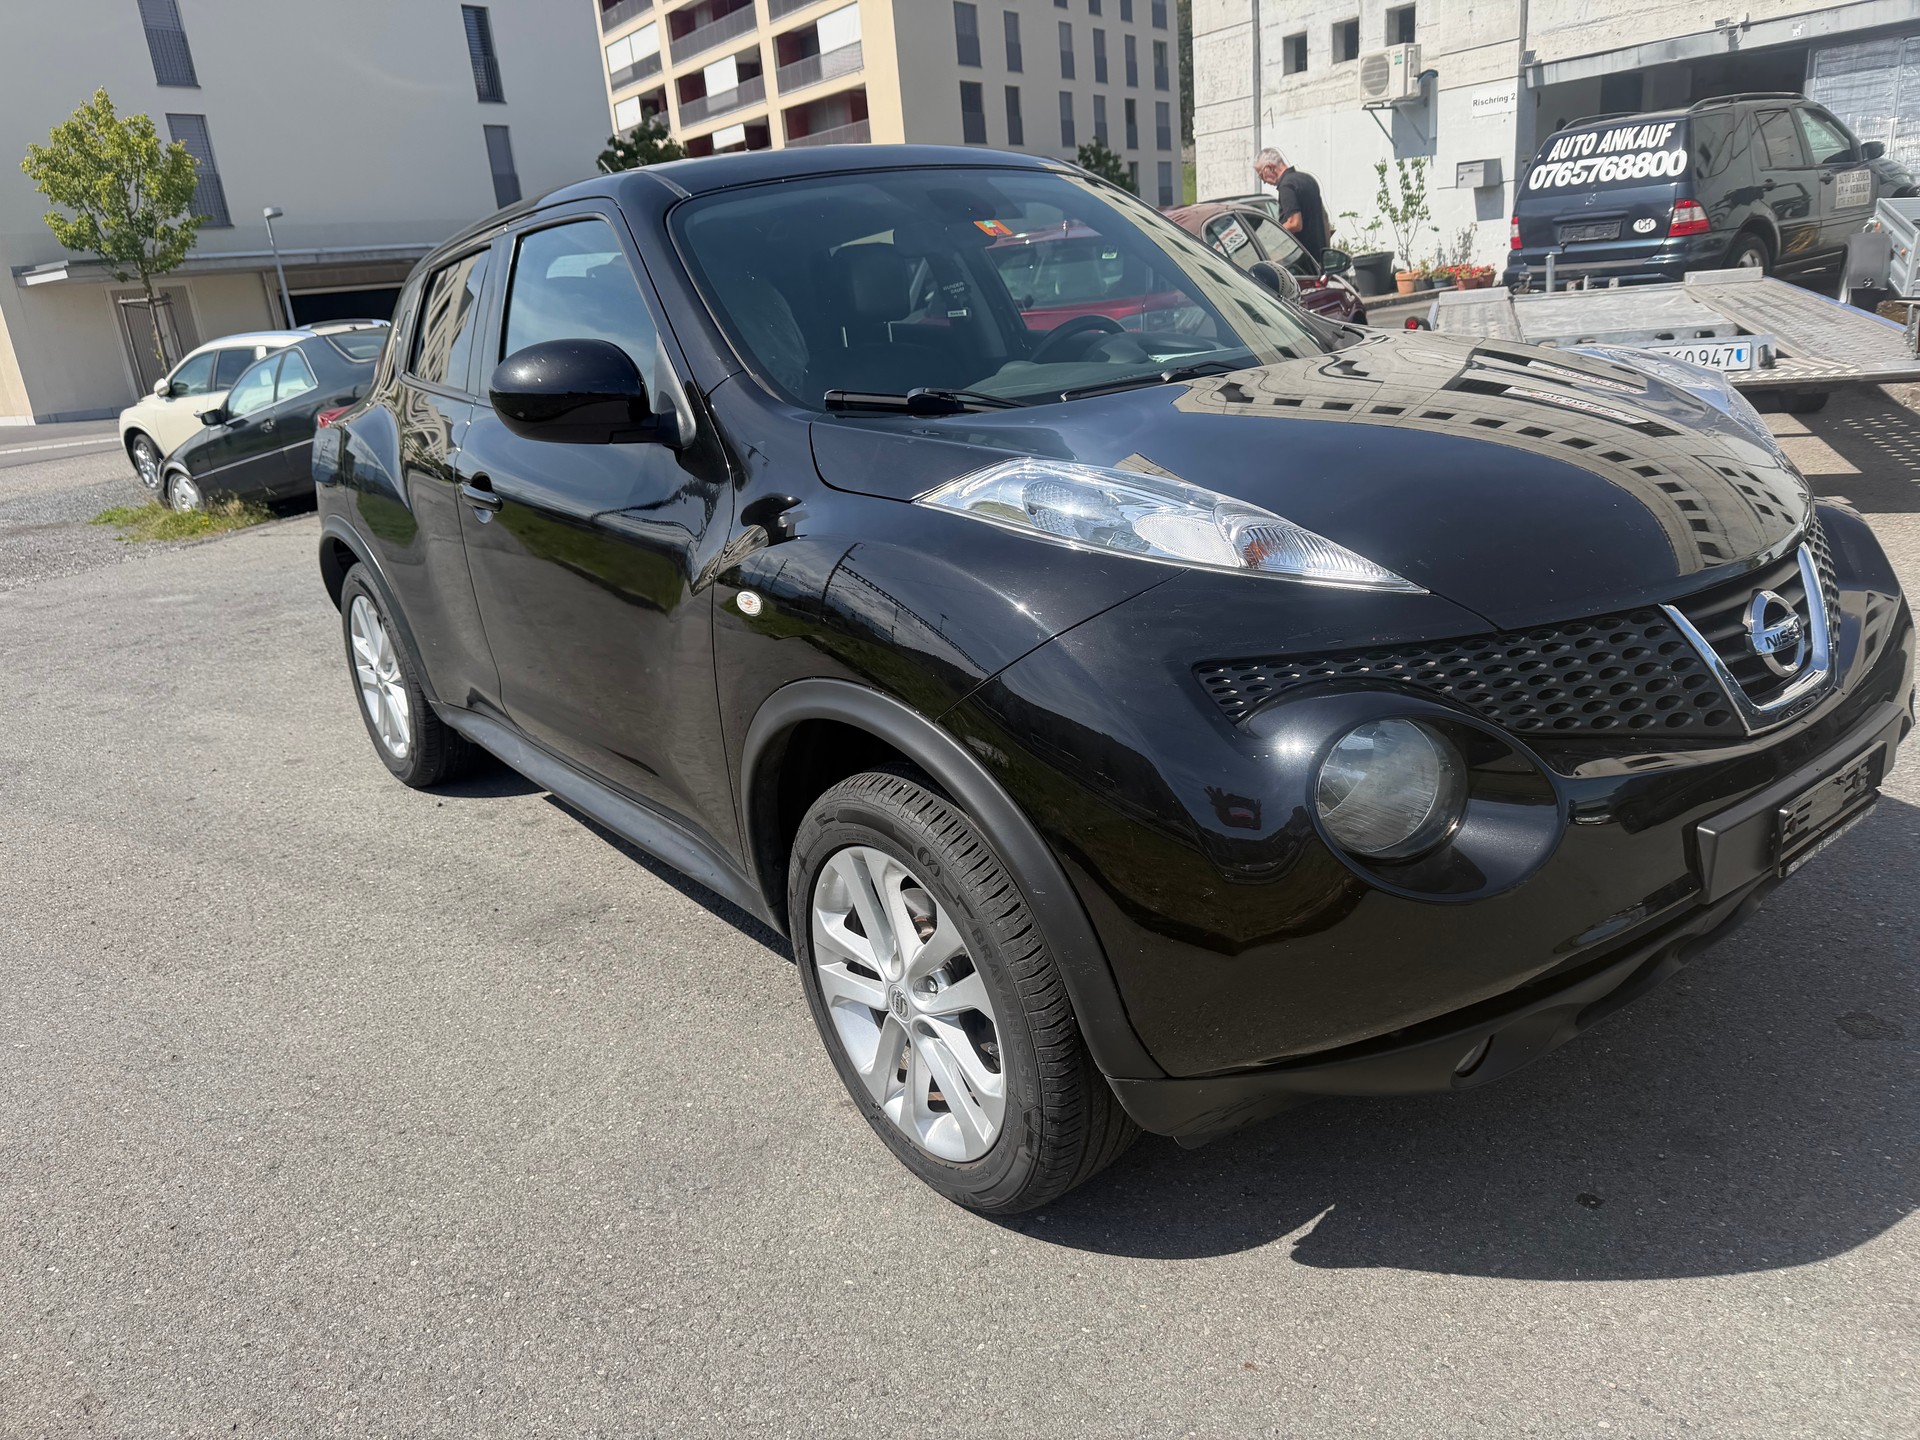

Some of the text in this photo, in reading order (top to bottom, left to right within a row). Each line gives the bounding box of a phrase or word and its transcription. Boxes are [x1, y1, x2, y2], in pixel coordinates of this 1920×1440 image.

[1472, 92, 1516, 107] Rischring 2
[1546, 122, 1676, 162] AUTO ANKAUF
[1528, 148, 1688, 191] 0765768800
[1638, 218, 1652, 230] CH
